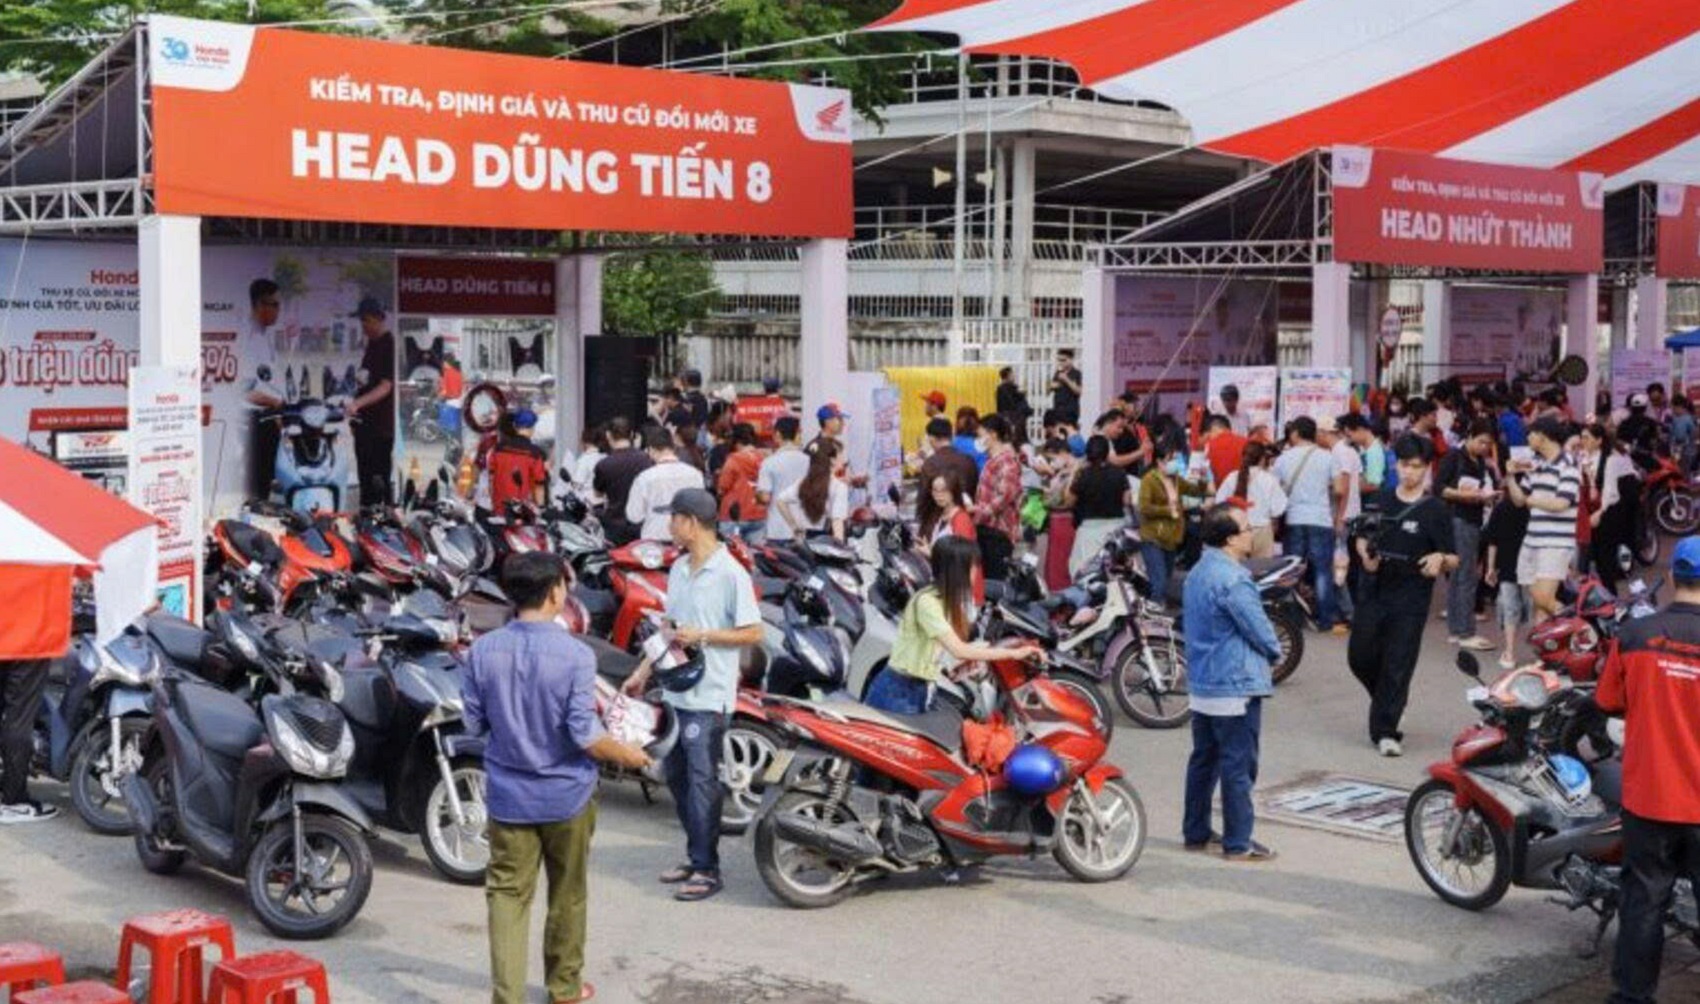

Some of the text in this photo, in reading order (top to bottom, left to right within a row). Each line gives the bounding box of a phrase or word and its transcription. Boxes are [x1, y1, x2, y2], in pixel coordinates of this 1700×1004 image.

[377, 84, 432, 113] TRA,
[437, 90, 494, 118] ĐỊNH
[500, 93, 538, 117] GIÁ
[543, 96, 571, 120] VÀ
[577, 102, 617, 124] THU
[622, 102, 650, 127] CŨ
[695, 109, 729, 134] MỚI
[734, 116, 757, 135] XE
[292, 128, 772, 203] HEAD DŨNG TIẾN 8
[1381, 208, 1572, 248] HEAD NHỨT THÀNH
[91, 269, 140, 285] Hond
[400, 277, 448, 294] HEAD
[452, 275, 498, 295] DŨNG
[11, 341, 73, 393] triệu
